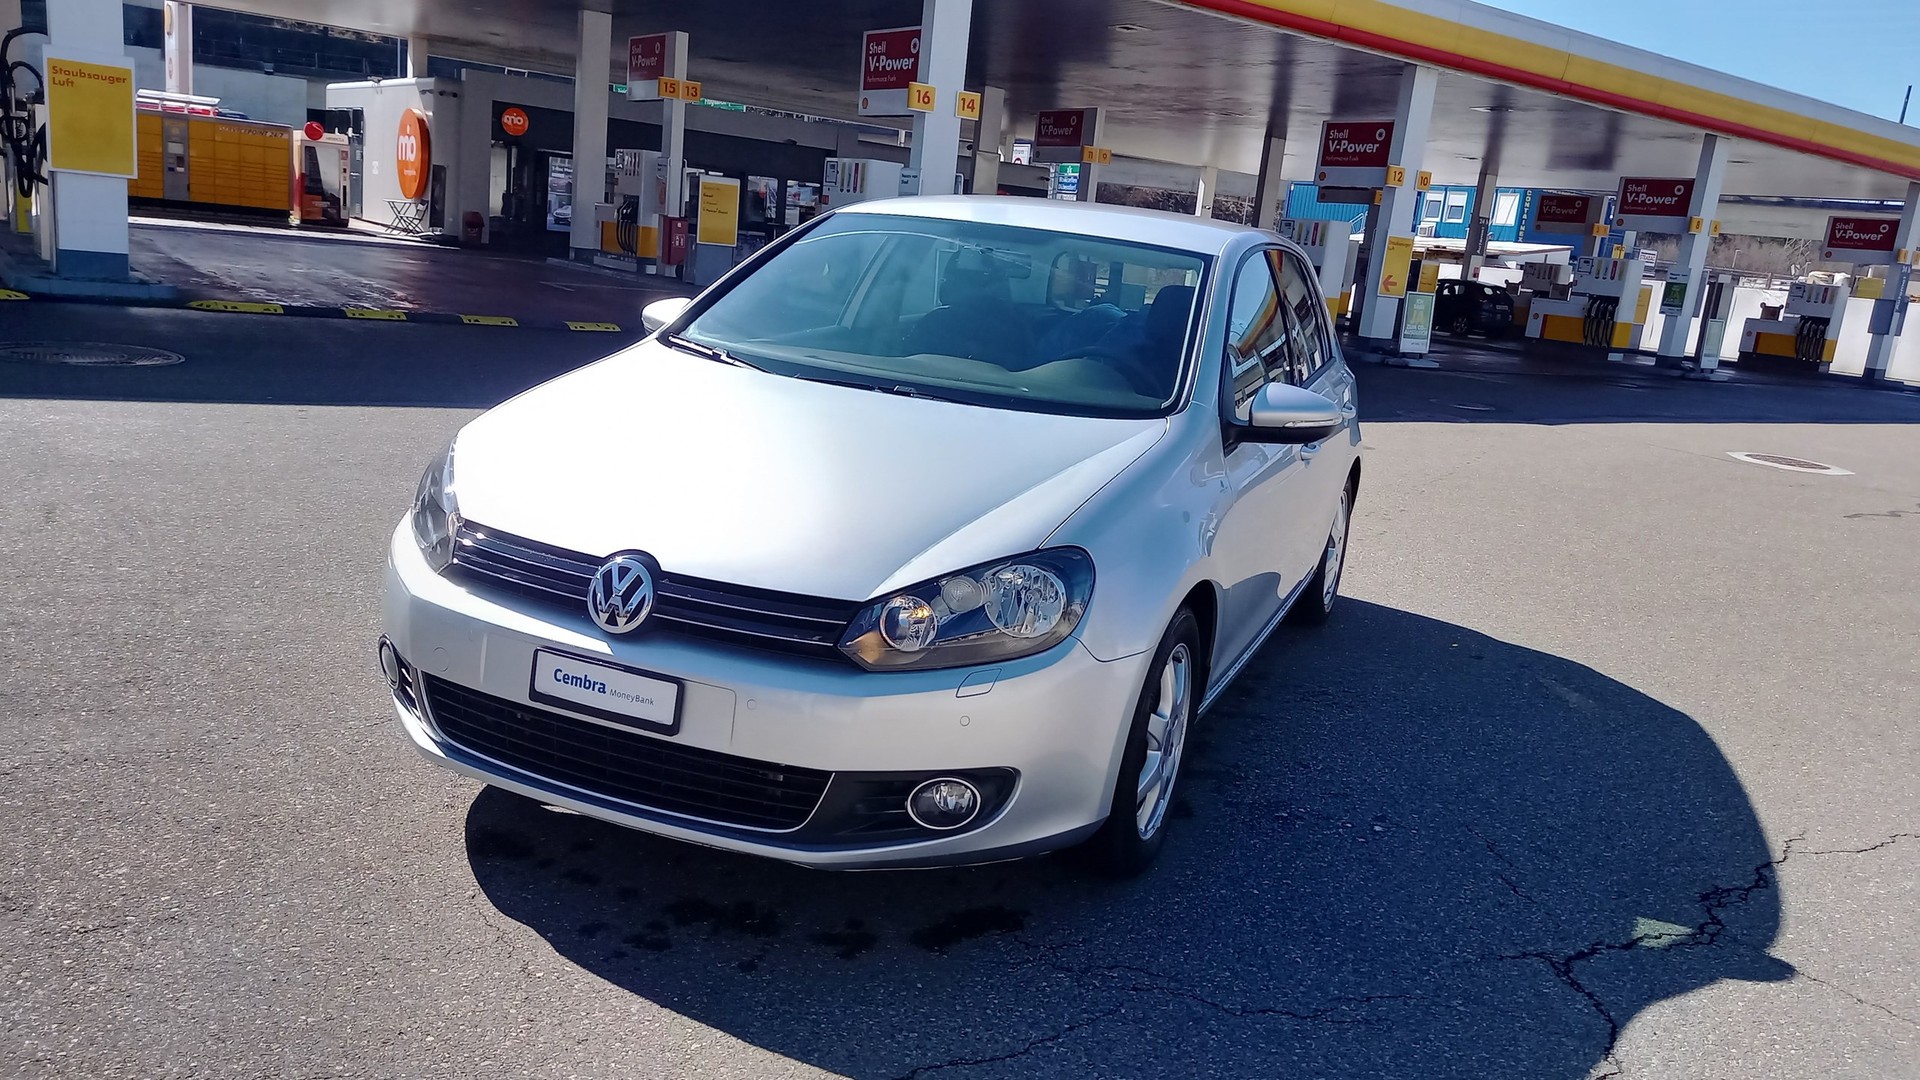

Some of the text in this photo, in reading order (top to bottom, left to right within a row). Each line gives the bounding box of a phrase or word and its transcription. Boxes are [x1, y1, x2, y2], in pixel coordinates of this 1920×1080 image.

[632, 44, 642, 54] Shell
[869, 41, 887, 54] Shell
[632, 56, 658, 68] V-Power
[869, 55, 915, 72] V-Power
[52, 65, 128, 85] Staubsauger
[52, 77, 75, 87] Luft
[663, 82, 676, 94] 15
[685, 85, 698, 98] 13
[916, 89, 931, 105] 16
[961, 97, 976, 113] 14
[1041, 116, 1054, 125] Shell
[1040, 125, 1073, 136] V-Power
[1329, 129, 1349, 139] Shell
[398, 124, 417, 162] mio
[1328, 139, 1380, 153] V-Power
[1393, 170, 1403, 182] 12
[1420, 176, 1429, 186] 10
[1627, 183, 1648, 193] Shell
[1626, 193, 1678, 205] V-Power
[1542, 206, 1578, 215] V-Power
[1695, 220, 1701, 230] 8
[1713, 225, 1718, 233] 6
[1835, 222, 1854, 230] Shell
[1834, 229, 1884, 241] V-Power
[553, 668, 655, 706] Cembra MoneyBank
